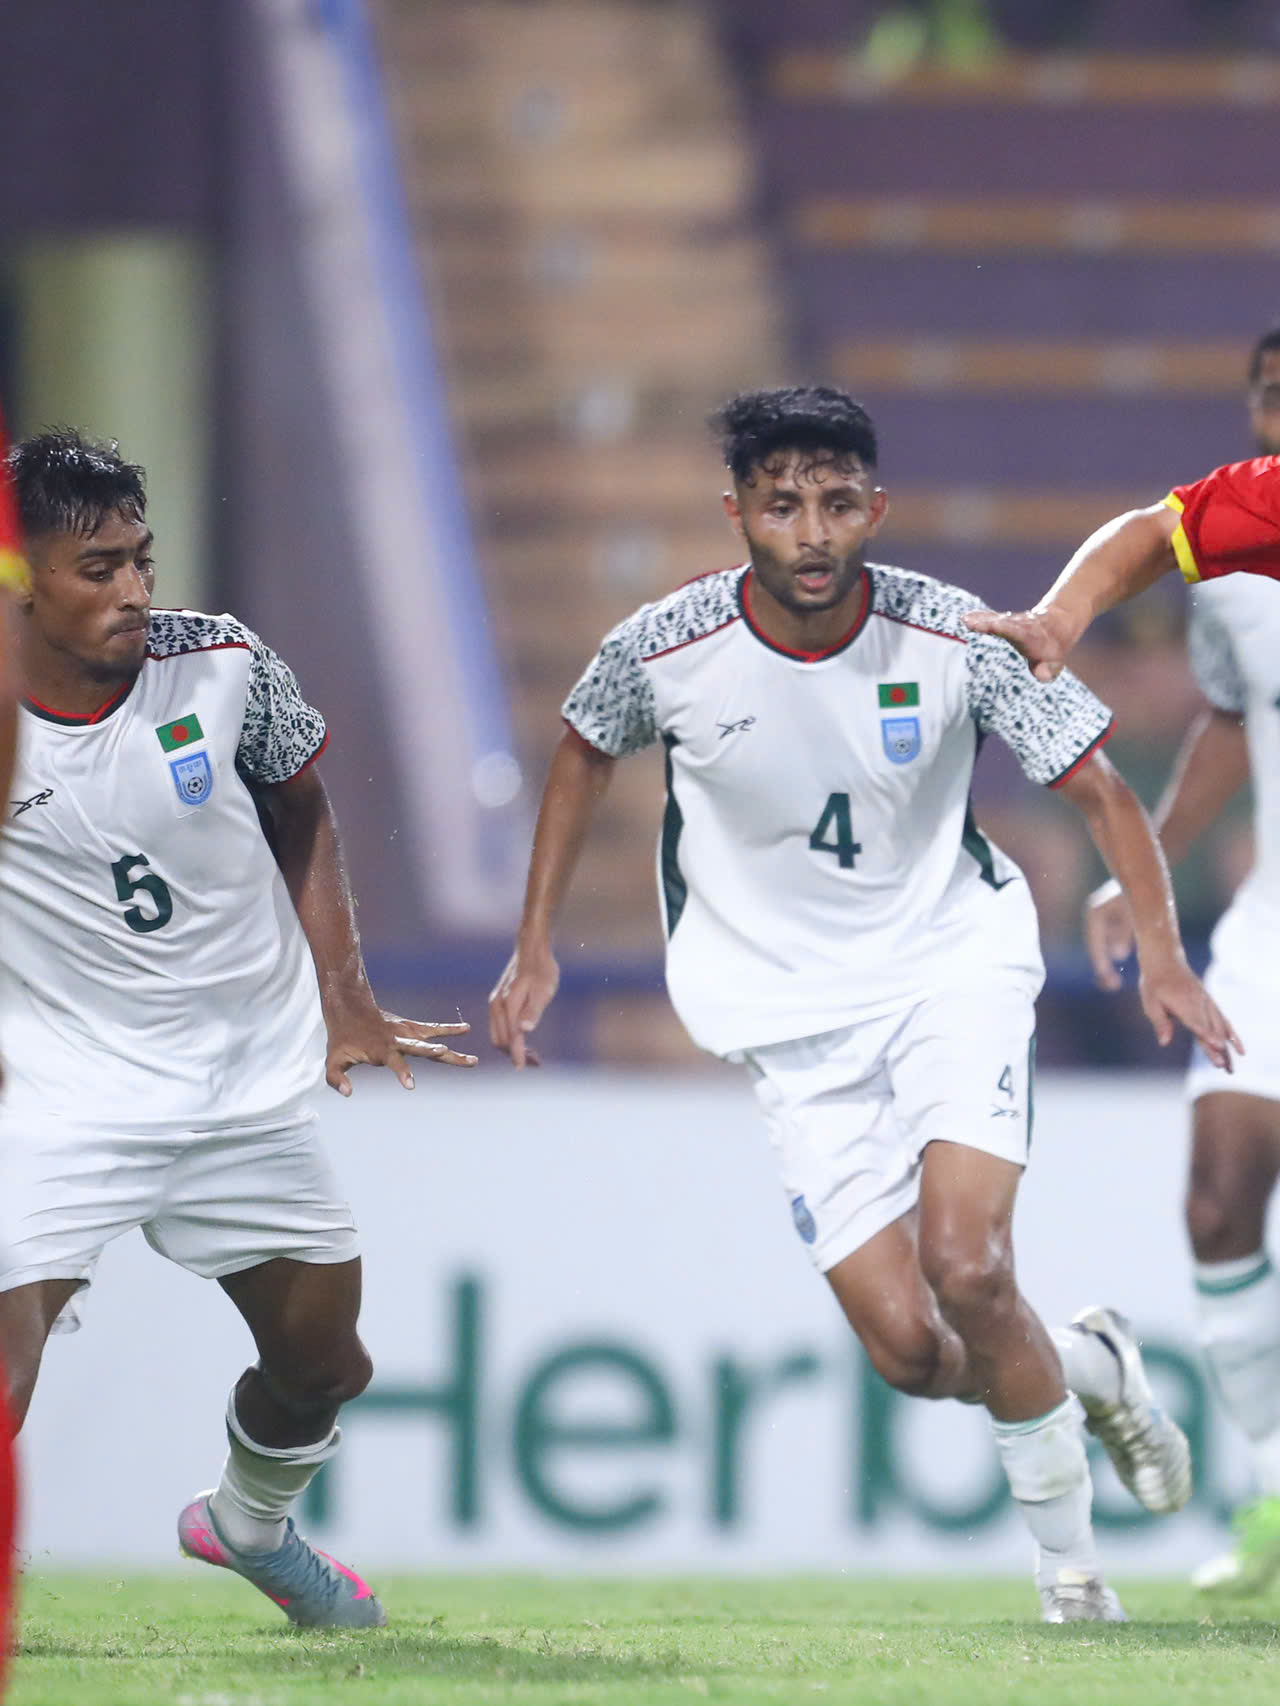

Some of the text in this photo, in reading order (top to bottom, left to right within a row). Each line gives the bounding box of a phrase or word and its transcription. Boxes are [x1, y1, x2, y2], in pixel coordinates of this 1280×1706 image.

[809, 792, 862, 869] 4
[111, 852, 173, 933] 5
[998, 1064, 1015, 1101] 4
